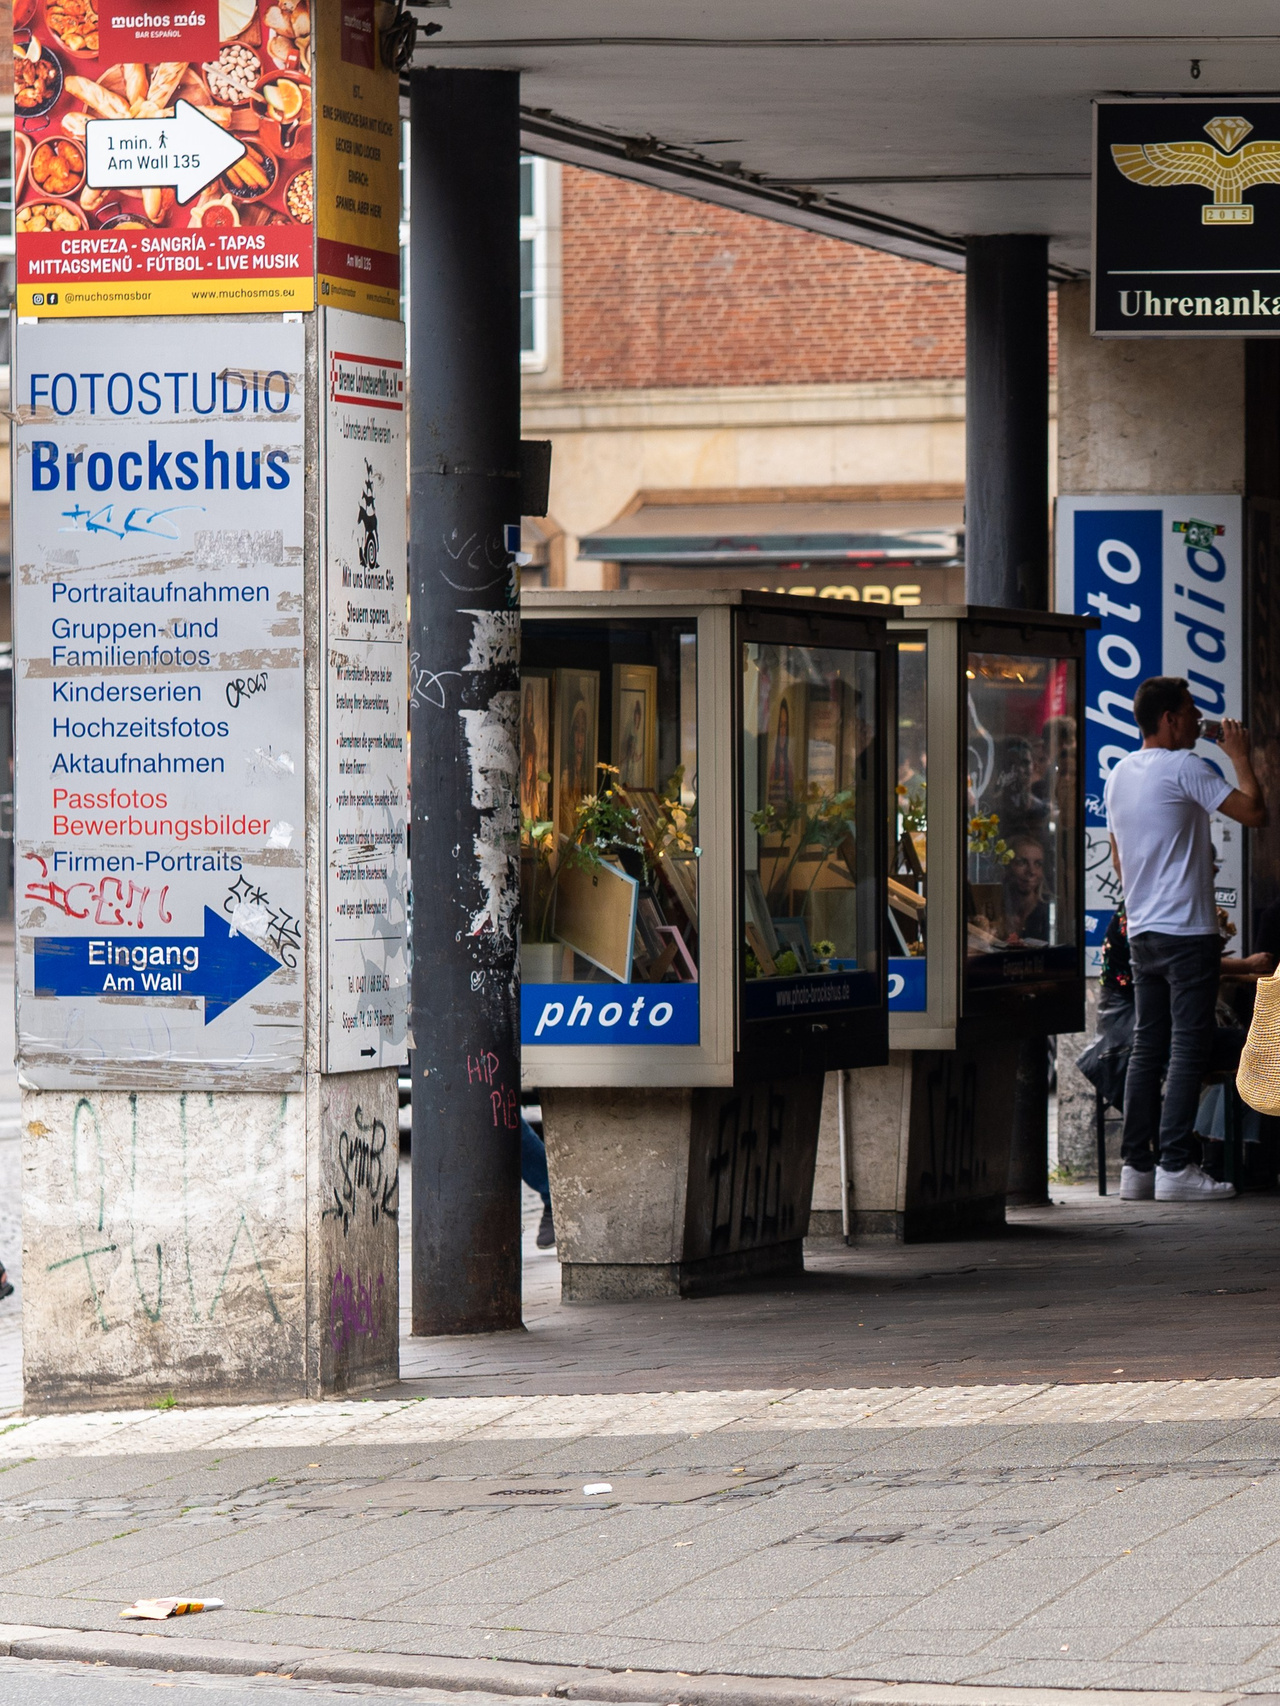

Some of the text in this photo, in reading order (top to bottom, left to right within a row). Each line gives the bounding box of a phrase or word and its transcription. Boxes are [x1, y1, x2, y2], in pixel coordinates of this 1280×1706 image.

[111, 12, 206, 28] muchos más
[135, 29, 181, 39] BAR ESPAÑOL
[107, 135, 152, 151] 1 min.
[107, 154, 200, 170] Am Wall 135
[61, 234, 265, 255] CERVEZA SANGRÍA TAPAS
[29, 252, 300, 275] MITTAGSMENÜ FÚTBOL LIVE MUSIK
[346, 253, 372, 271] Am Wall 135
[64, 290, 152, 304] @muchosmasbar
[191, 287, 295, 301] www.muchosmas.eu
[338, 364, 355, 391] Bremer
[355, 366, 389, 398] Lohnsteuerhilfe
[30, 371, 290, 416] FOTOSTUDIO
[31, 439, 290, 491] Brockshus
[341, 566, 394, 591] Mit uns können Sie
[52, 582, 270, 603] Portraitaufnahmen
[346, 601, 391, 629] Steuern sparen.
[51, 618, 219, 644] Gruppen- und
[52, 645, 210, 667] Familienfotos
[53, 681, 201, 702] Kinderserien
[53, 716, 230, 738] Hochzeitsfotos
[51, 753, 225, 774] Aktaufnahmen
[53, 788, 168, 809] Passfotos
[53, 814, 271, 841] Bewerbungsbilder
[53, 851, 243, 872] Firmen-Portraits
[88, 940, 200, 971] Eingang
[103, 973, 182, 991] Am Wall
[379, 1010, 395, 1027] Bremen
[534, 995, 673, 1036] photo
